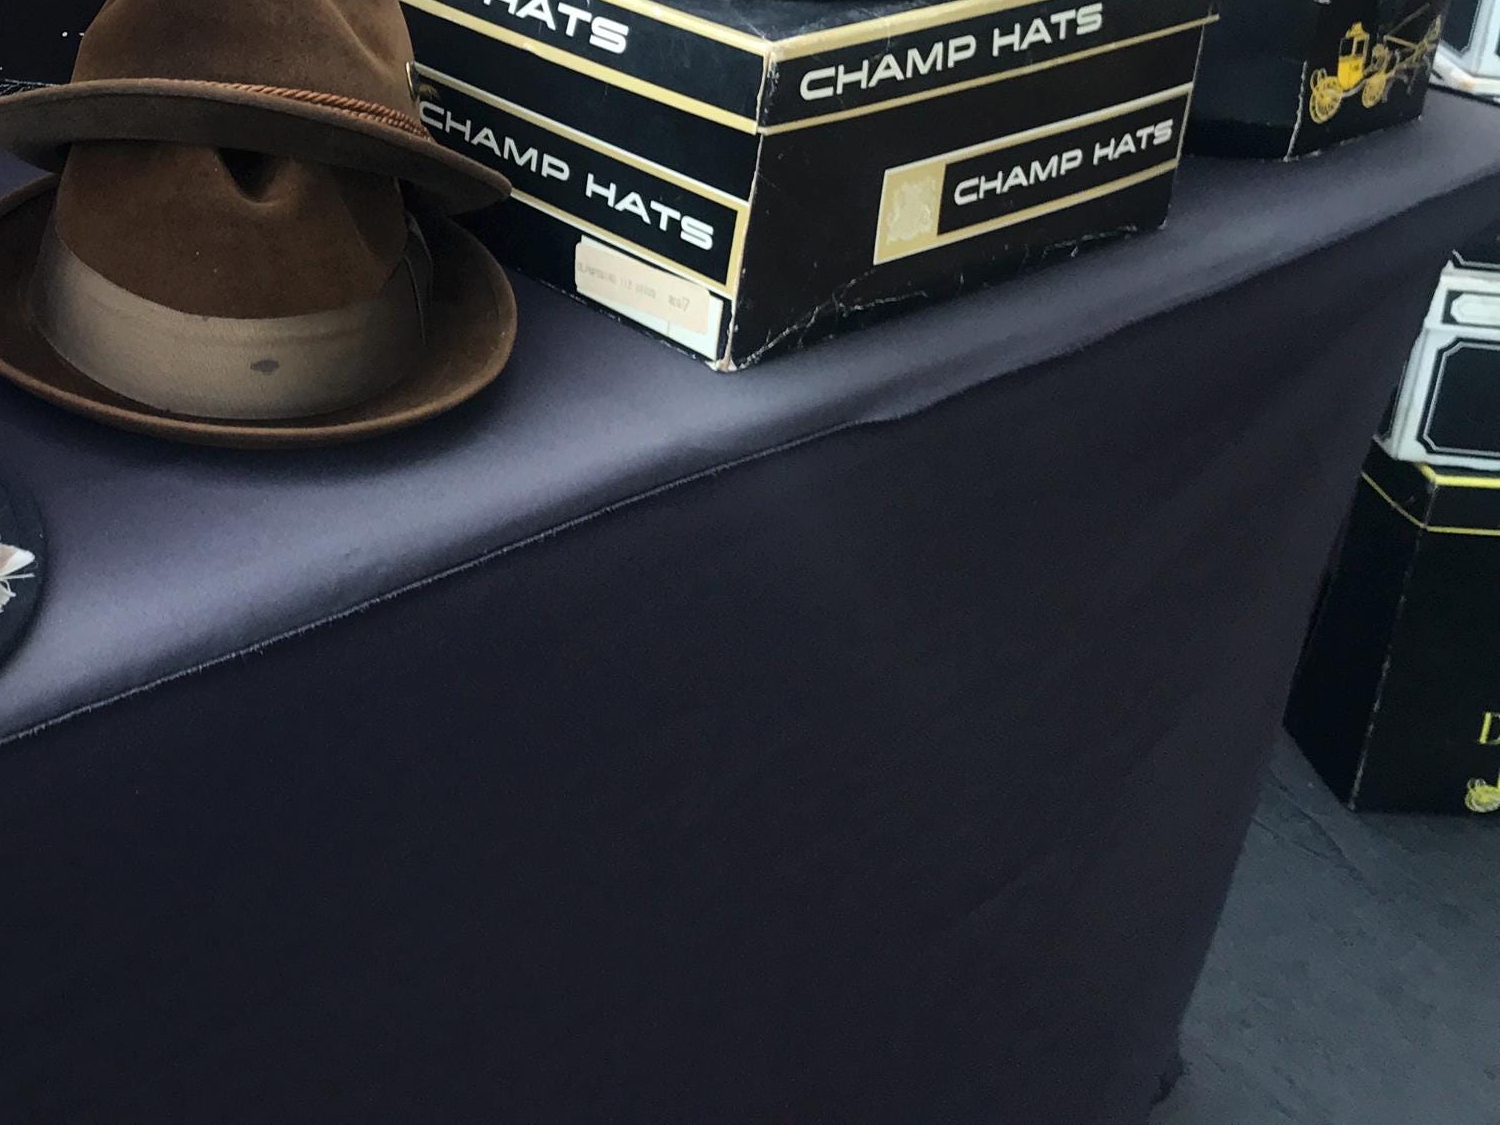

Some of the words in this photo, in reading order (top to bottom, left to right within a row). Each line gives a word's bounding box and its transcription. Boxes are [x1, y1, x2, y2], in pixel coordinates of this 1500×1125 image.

[799, 33, 978, 101] CHAMP
[992, 2, 1104, 58] HATS
[419, 100, 571, 182] CHAMP
[584, 172, 715, 252] HATS
[953, 147, 1084, 206] CHAMP
[1093, 118, 1174, 166] HATS
